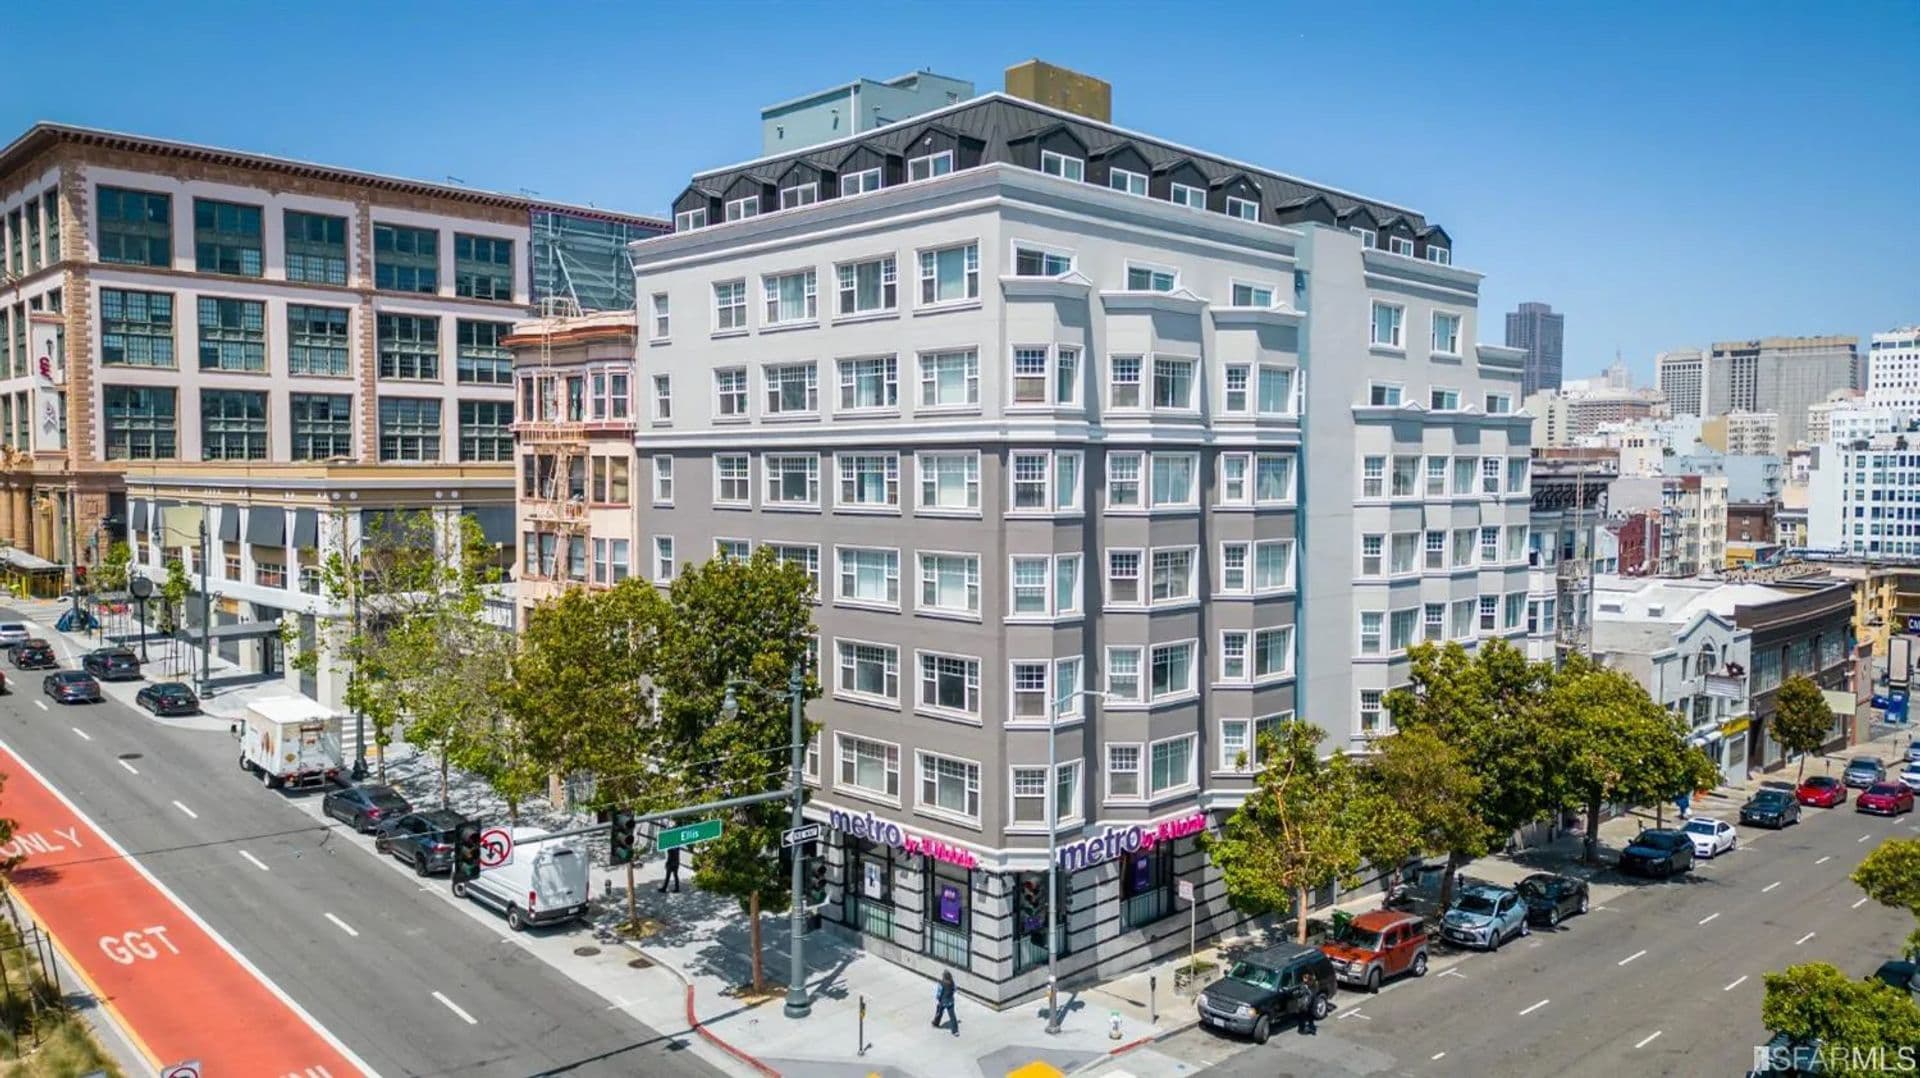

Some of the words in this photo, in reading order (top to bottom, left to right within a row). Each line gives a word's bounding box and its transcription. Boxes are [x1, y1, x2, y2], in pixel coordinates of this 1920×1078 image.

[680, 829, 700, 841] Ellis
[829, 809, 902, 847] metro
[1057, 825, 1142, 871] metro
[98, 925, 180, 965] GGT
